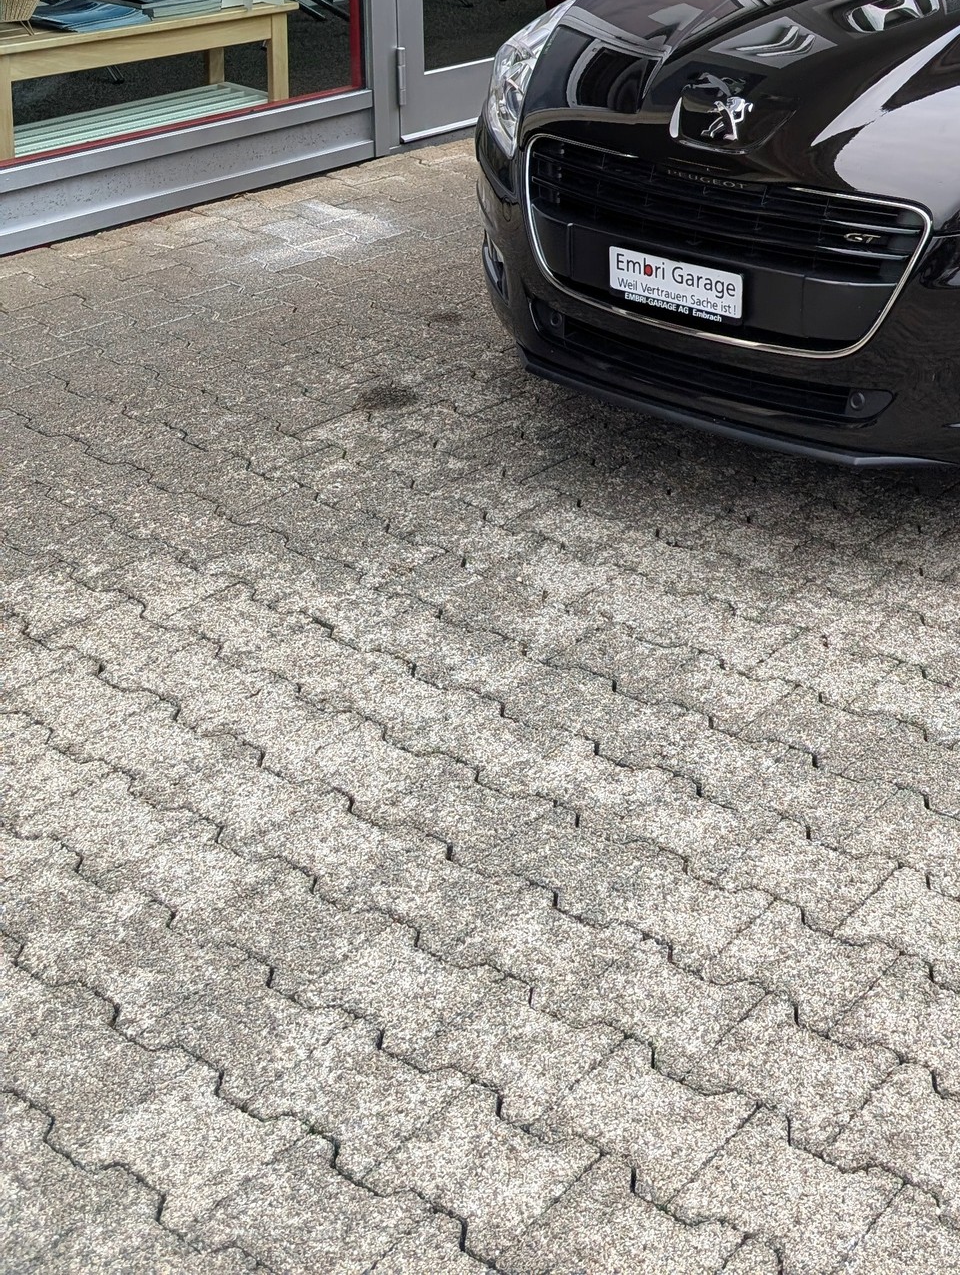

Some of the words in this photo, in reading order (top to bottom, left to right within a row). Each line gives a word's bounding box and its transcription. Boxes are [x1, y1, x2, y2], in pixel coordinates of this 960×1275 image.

[667, 169, 750, 190] PEUGEOT
[843, 232, 882, 244] GT
[616, 252, 665, 280] Embri
[671, 266, 736, 299] Garage
[617, 277, 638, 292] Weil
[640, 282, 688, 303] Vertrauen
[690, 294, 718, 311] Sache
[624, 292, 678, 312] EMBRI-GARAGE
[678, 305, 689, 315] AG
[692, 308, 723, 323] Embrach
